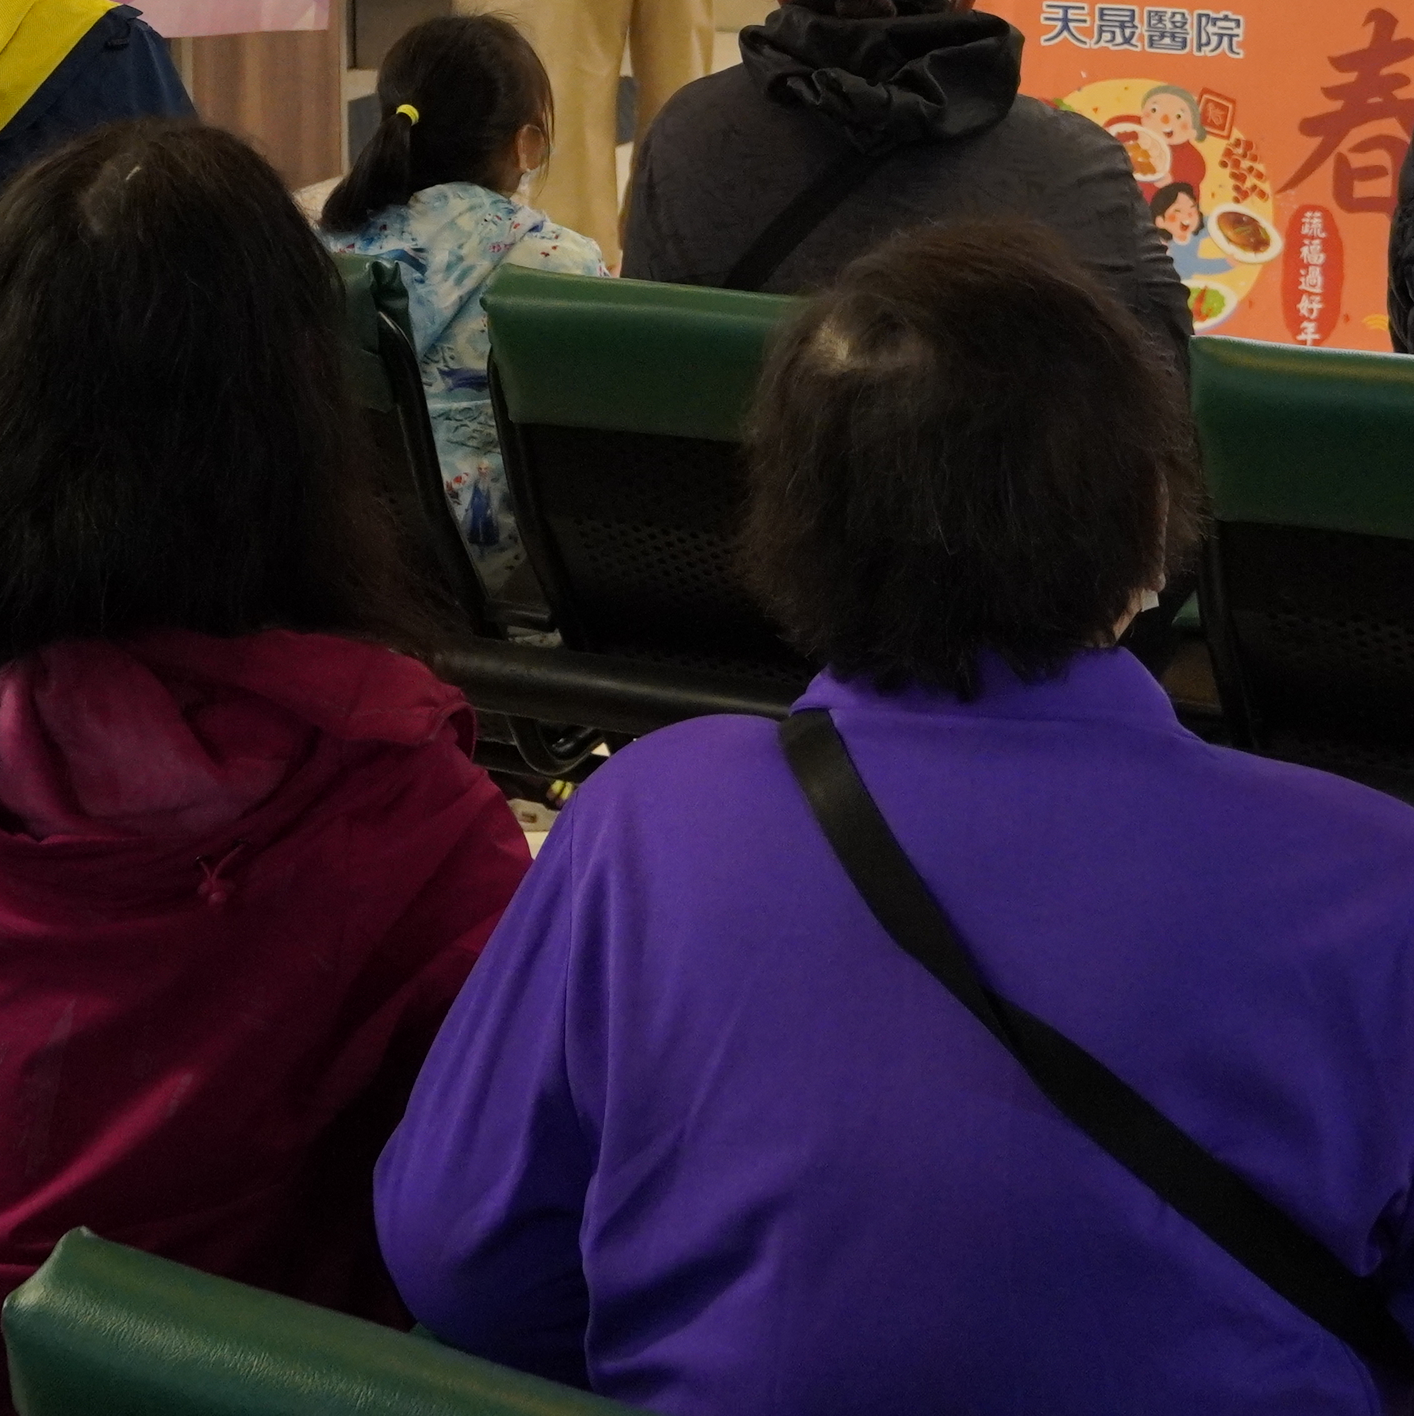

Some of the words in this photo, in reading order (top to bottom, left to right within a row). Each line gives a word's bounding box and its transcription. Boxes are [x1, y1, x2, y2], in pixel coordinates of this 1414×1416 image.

[1041, 1, 1243, 57] 天晟醫院
[1295, 210, 1326, 346] 蔬福過好年
